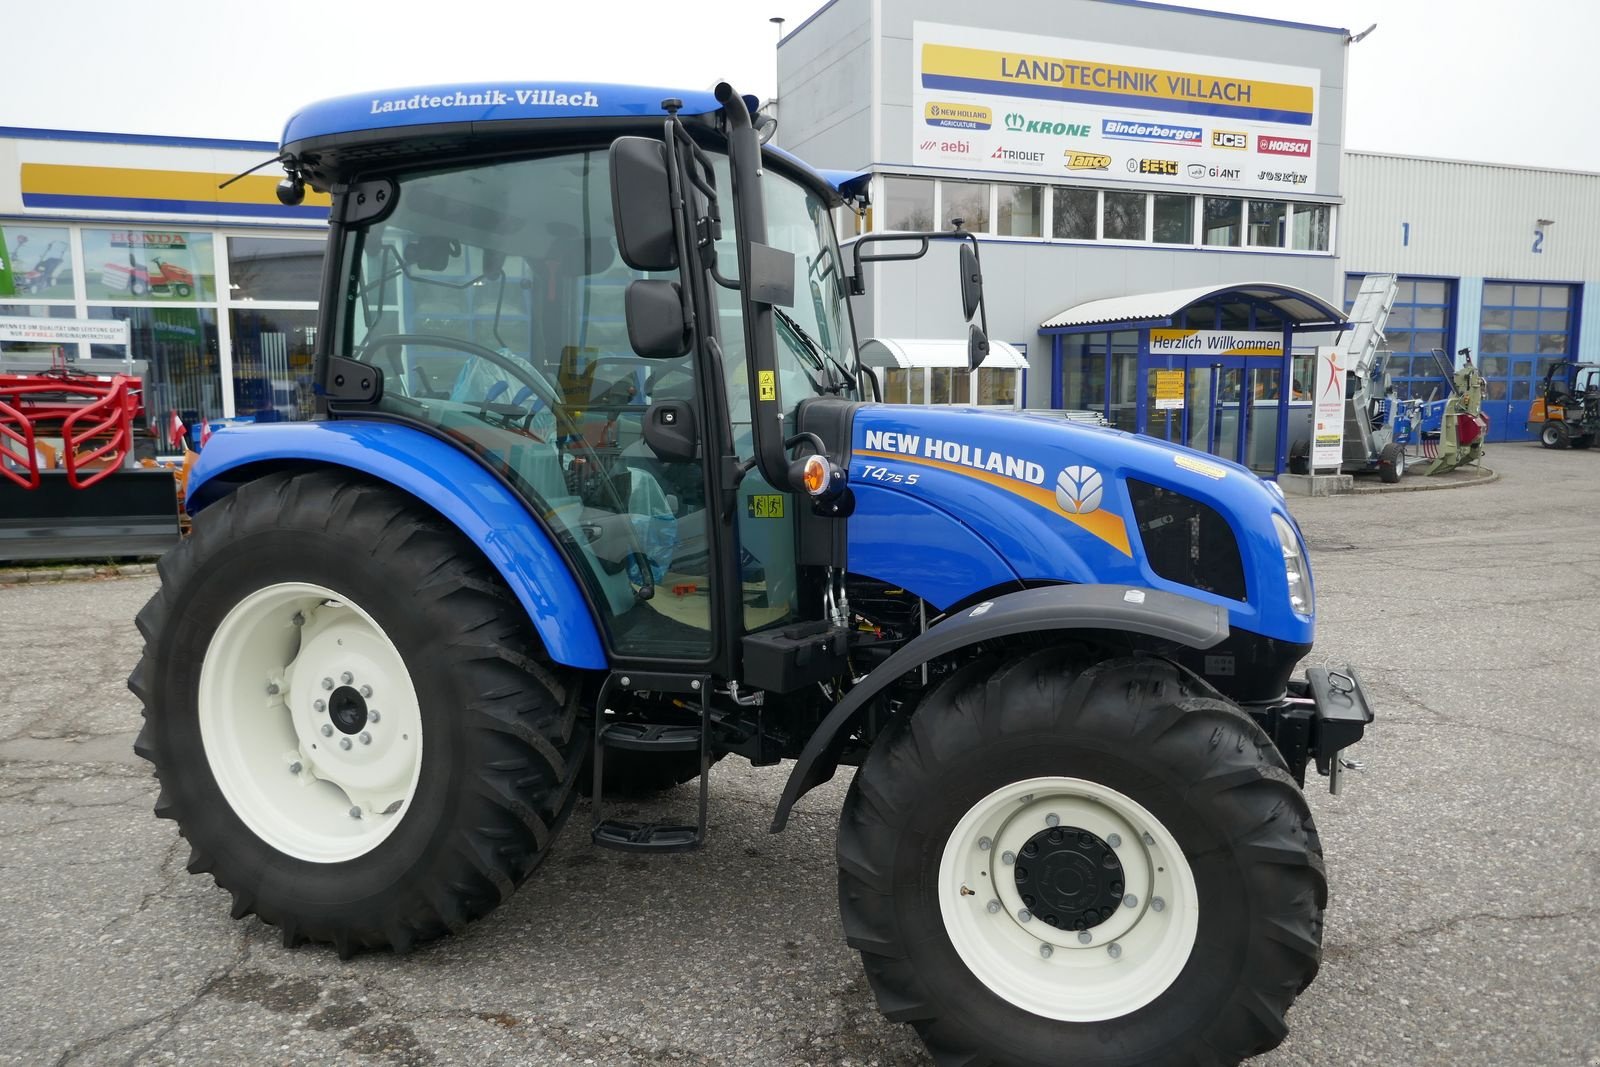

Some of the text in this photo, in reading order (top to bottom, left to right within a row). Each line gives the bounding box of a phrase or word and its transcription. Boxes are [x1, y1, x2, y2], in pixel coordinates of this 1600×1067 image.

[1001, 57, 1252, 103] LANDTECHNIK VILLACH
[369, 89, 600, 114] Landtechnik-Villach
[940, 108, 987, 119] NEW HOLLAND
[939, 120, 977, 129] AGRICULTURE
[1026, 120, 1091, 138] KRONE
[1105, 121, 1200, 141] Binderberger
[940, 140, 970, 153] aebi
[1213, 132, 1246, 148] JCB
[1267, 140, 1309, 153] HORSCH
[1002, 149, 1046, 162] TRIOLIET
[1063, 150, 1111, 169] Tanco
[111, 232, 187, 244] HONDA
[1402, 222, 1410, 247] 1
[1531, 230, 1544, 254] 2
[1153, 335, 1280, 351] Herzlich Willkommen
[865, 429, 1045, 485] NEW HOLLAND
[904, 474, 921, 485] S
